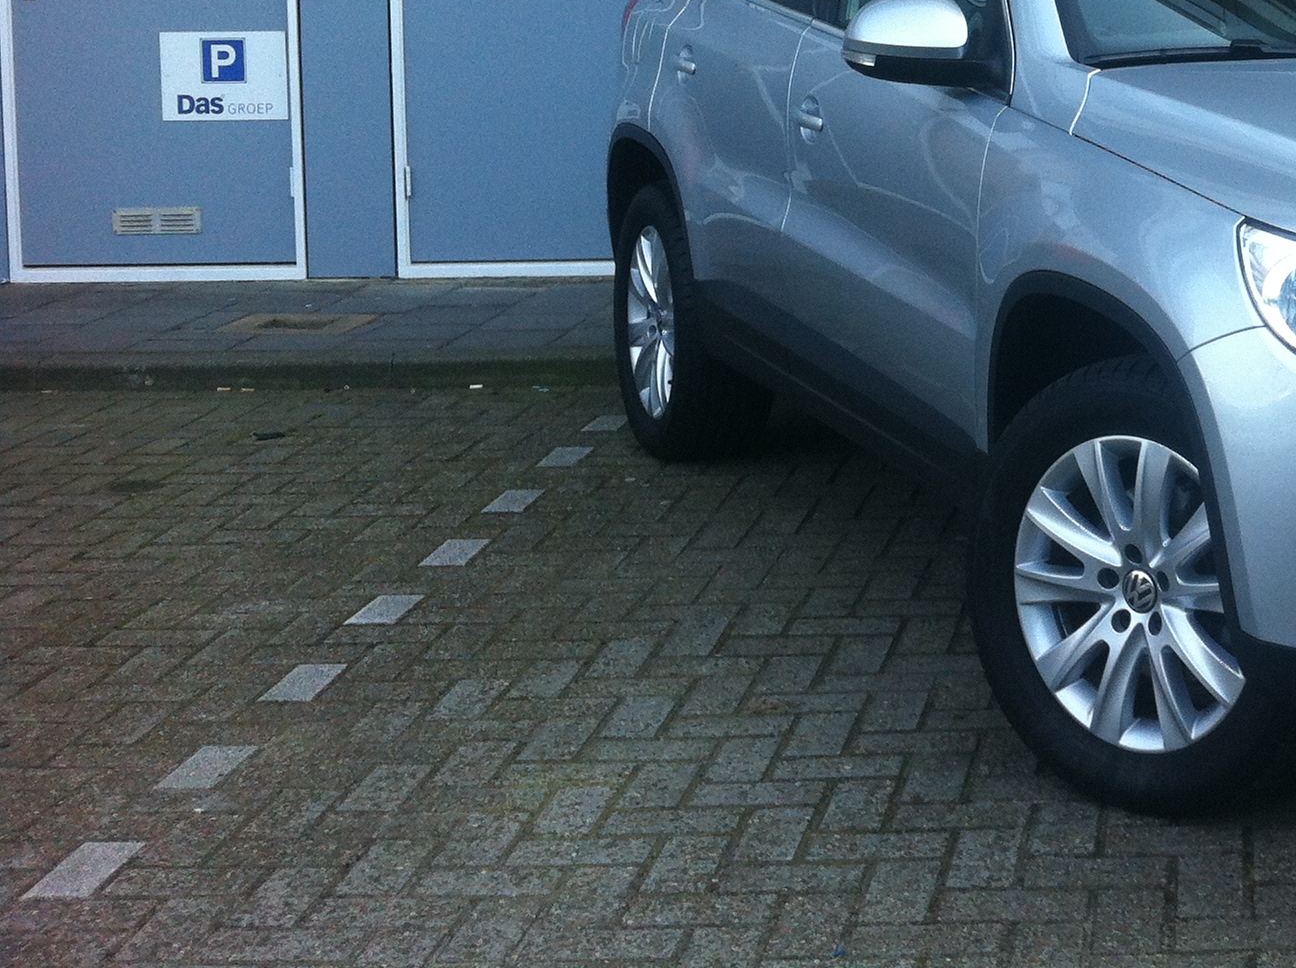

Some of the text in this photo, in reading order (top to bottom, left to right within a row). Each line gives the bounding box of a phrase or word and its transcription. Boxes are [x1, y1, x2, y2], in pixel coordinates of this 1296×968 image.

[210, 43, 237, 79] P
[177, 94, 274, 115] Das GROEP
